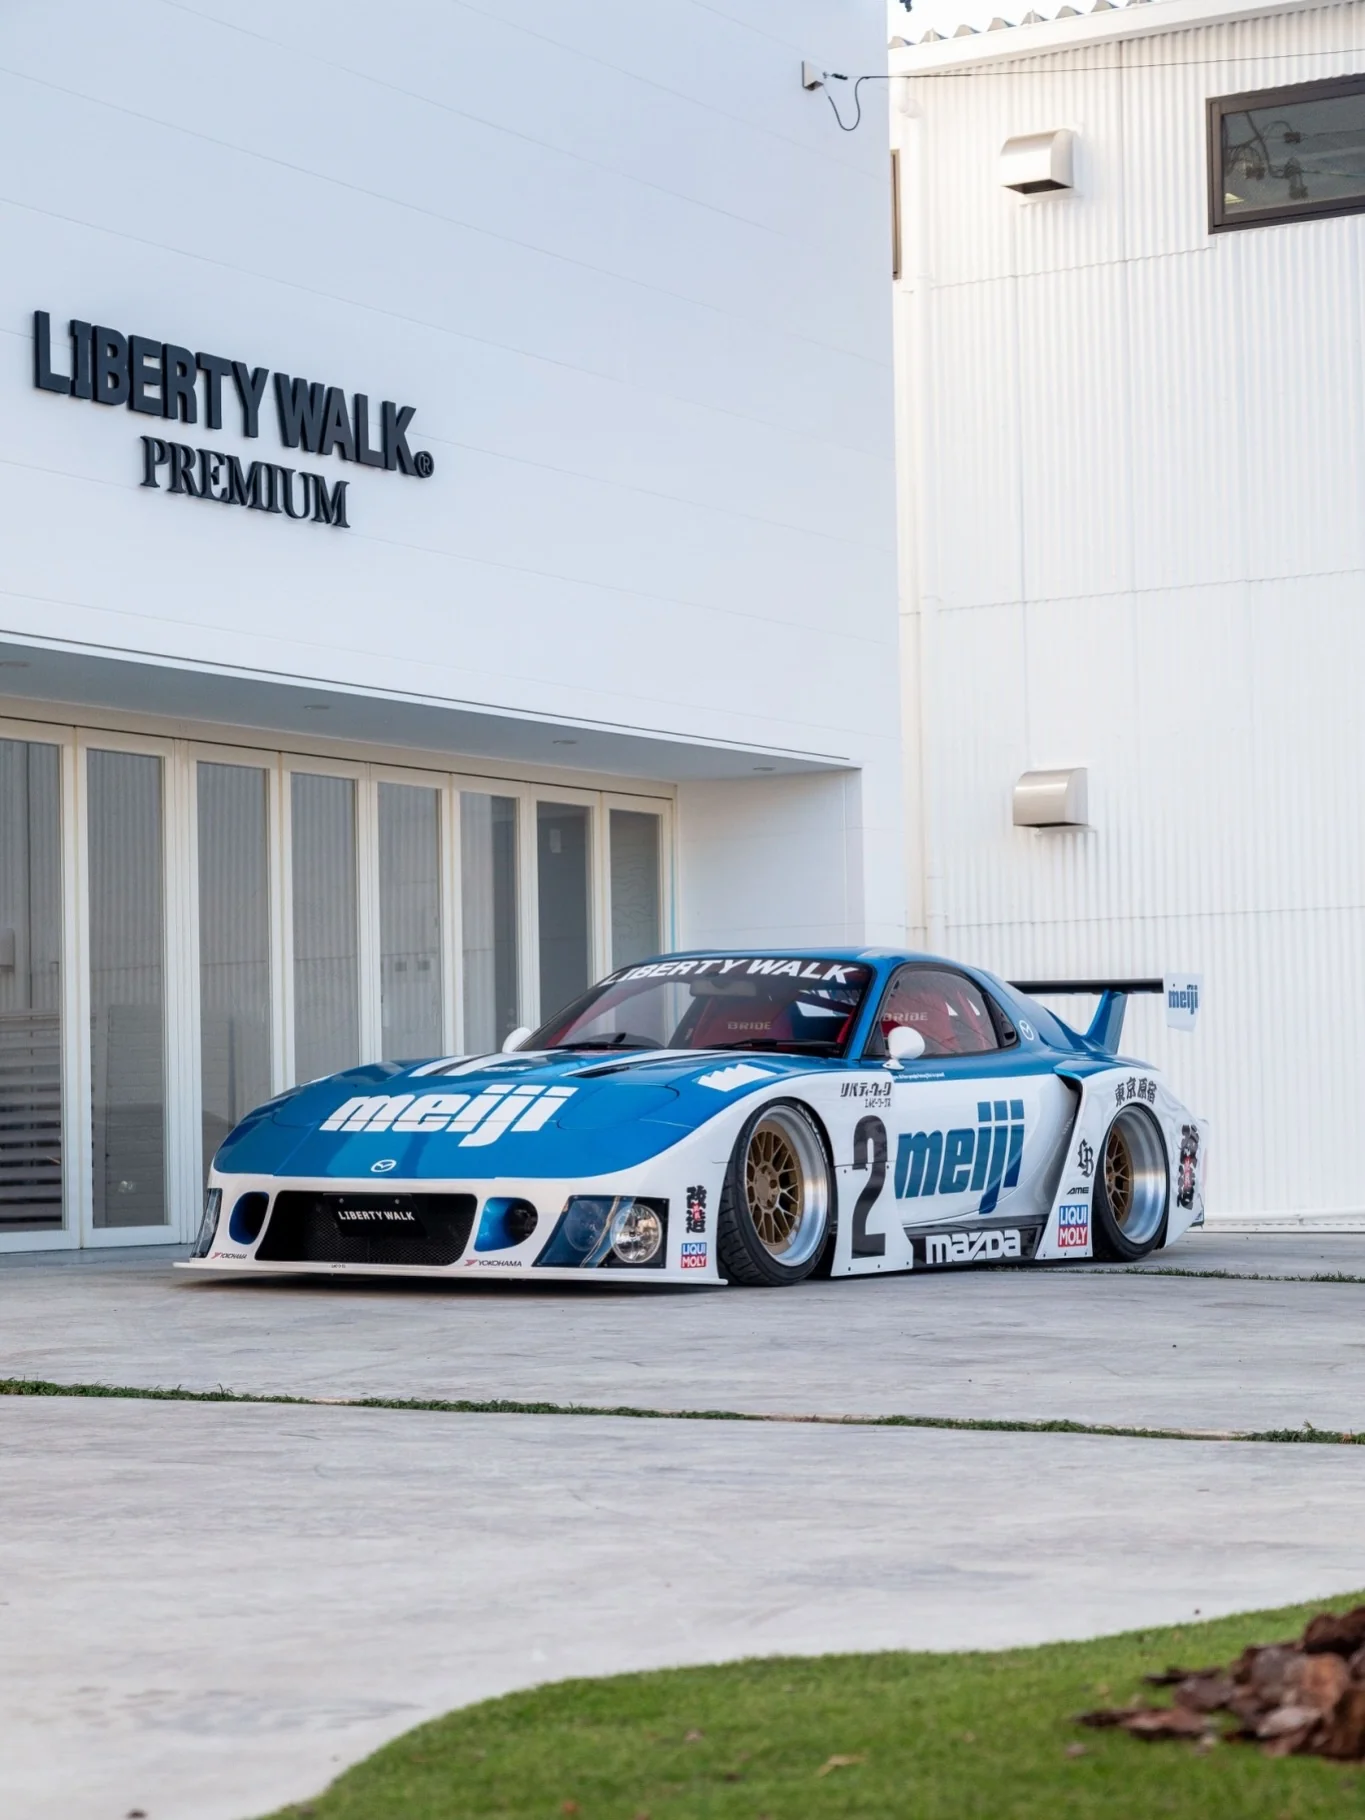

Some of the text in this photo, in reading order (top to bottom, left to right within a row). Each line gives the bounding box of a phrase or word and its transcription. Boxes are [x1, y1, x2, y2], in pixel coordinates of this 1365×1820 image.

[34, 310, 270, 438] LIBERTY
[140, 435, 351, 528] PREMIUM
[599, 959, 860, 987] LIBERTY WALK
[1168, 983, 1198, 1015] meiji
[727, 1021, 772, 1031] BRIDE
[319, 1084, 580, 1147] meiji
[894, 1099, 1025, 1215] meiji
[851, 1114, 887, 1260] 2
[1066, 1186, 1090, 1195] AME
[338, 1211, 414, 1221] LIBERTY WALK
[1060, 1206, 1088, 1226] LIQUI
[1058, 1227, 1088, 1246] MOLY
[683, 1244, 706, 1255] LIQUI
[478, 1259, 523, 1268] YOKOHAMA
[682, 1257, 706, 1267] MOLY
